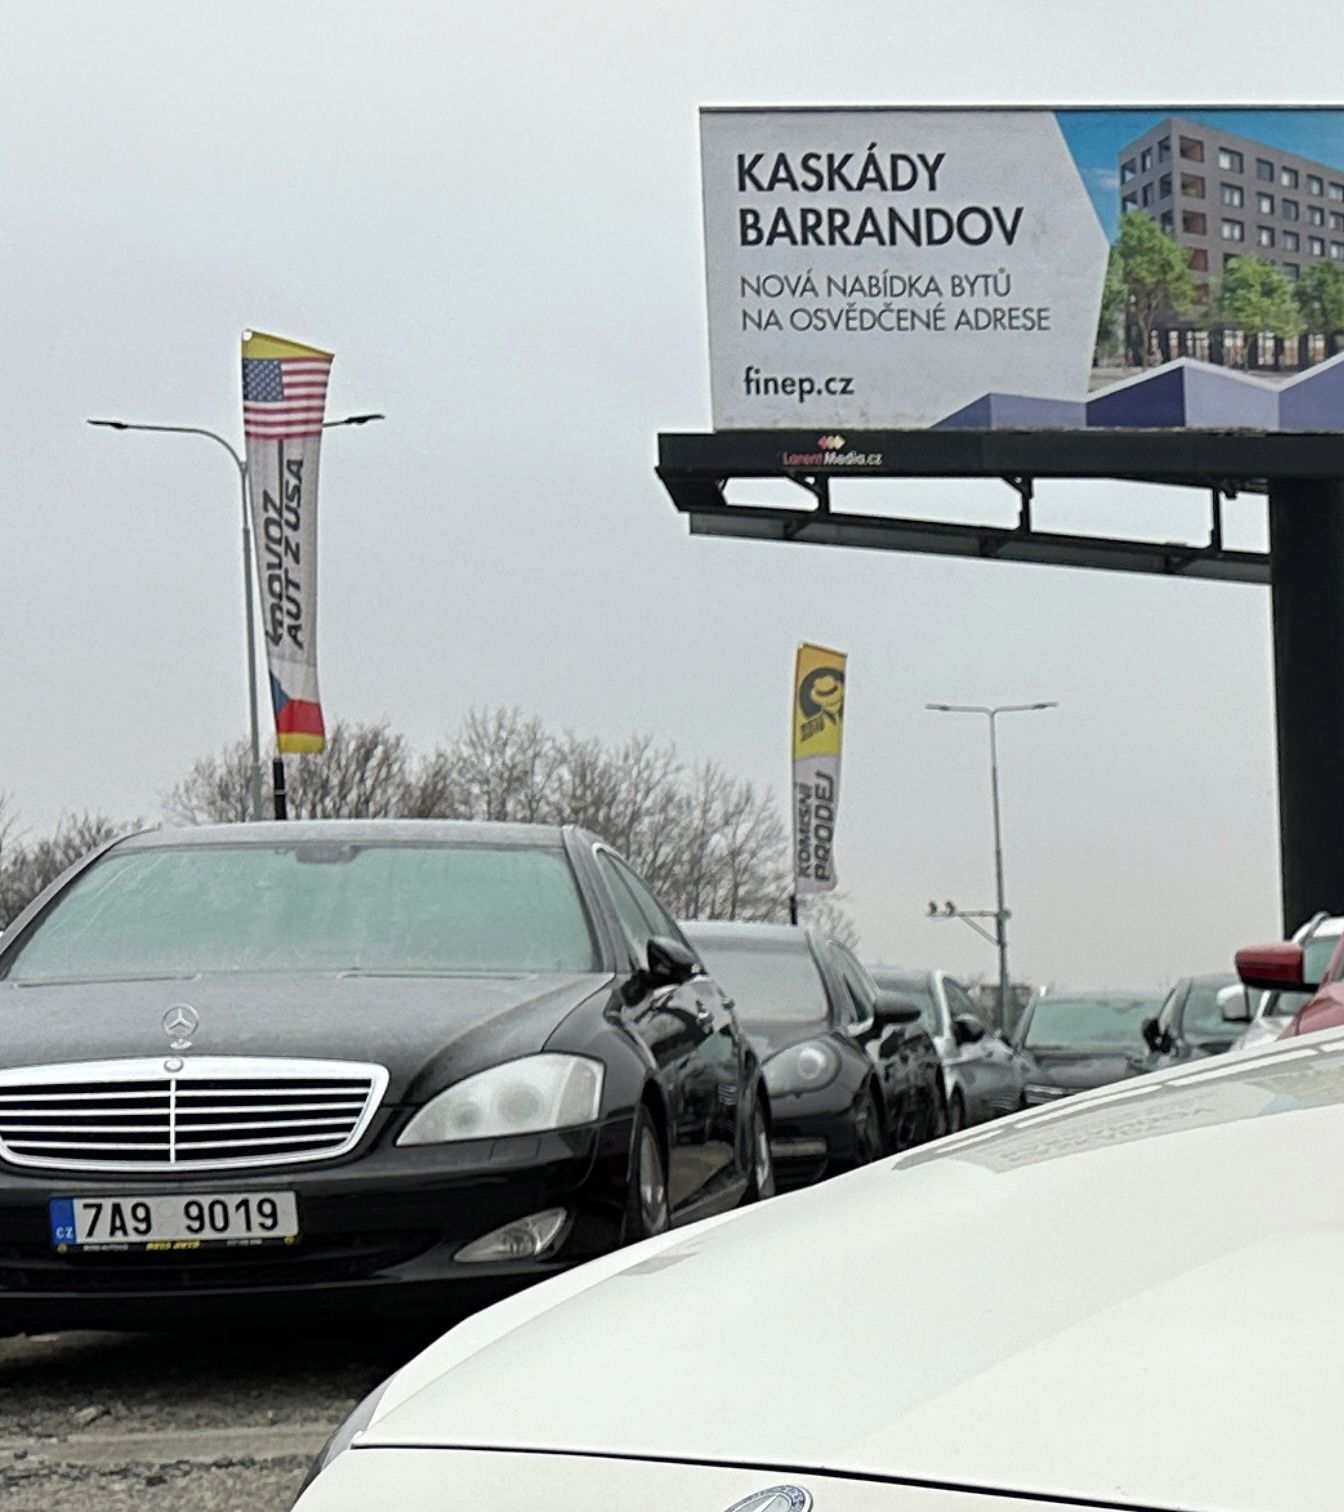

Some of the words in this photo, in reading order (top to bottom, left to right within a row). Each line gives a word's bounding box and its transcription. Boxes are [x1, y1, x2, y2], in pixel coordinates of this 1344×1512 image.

[737, 142, 946, 192] KASKÁDY
[739, 206, 1024, 247] BARRANDOV
[740, 268, 820, 298] NOVÁ
[827, 268, 944, 298] NABÍDKA
[950, 267, 1012, 298] BYTŮ
[742, 308, 783, 331] NA
[789, 302, 946, 332] OSVĚDČENÉ
[954, 307, 1051, 331] ADRESE
[744, 366, 856, 403] finep.cz
[285, 458, 304, 531] USA
[285, 536, 301, 565] Z
[285, 568, 303, 649] AUT
[814, 769, 834, 881] PRODEJ
[56, 1226, 74, 1239] CZ
[83, 1202, 152, 1238] 7A9
[184, 1198, 278, 1233] 9019
